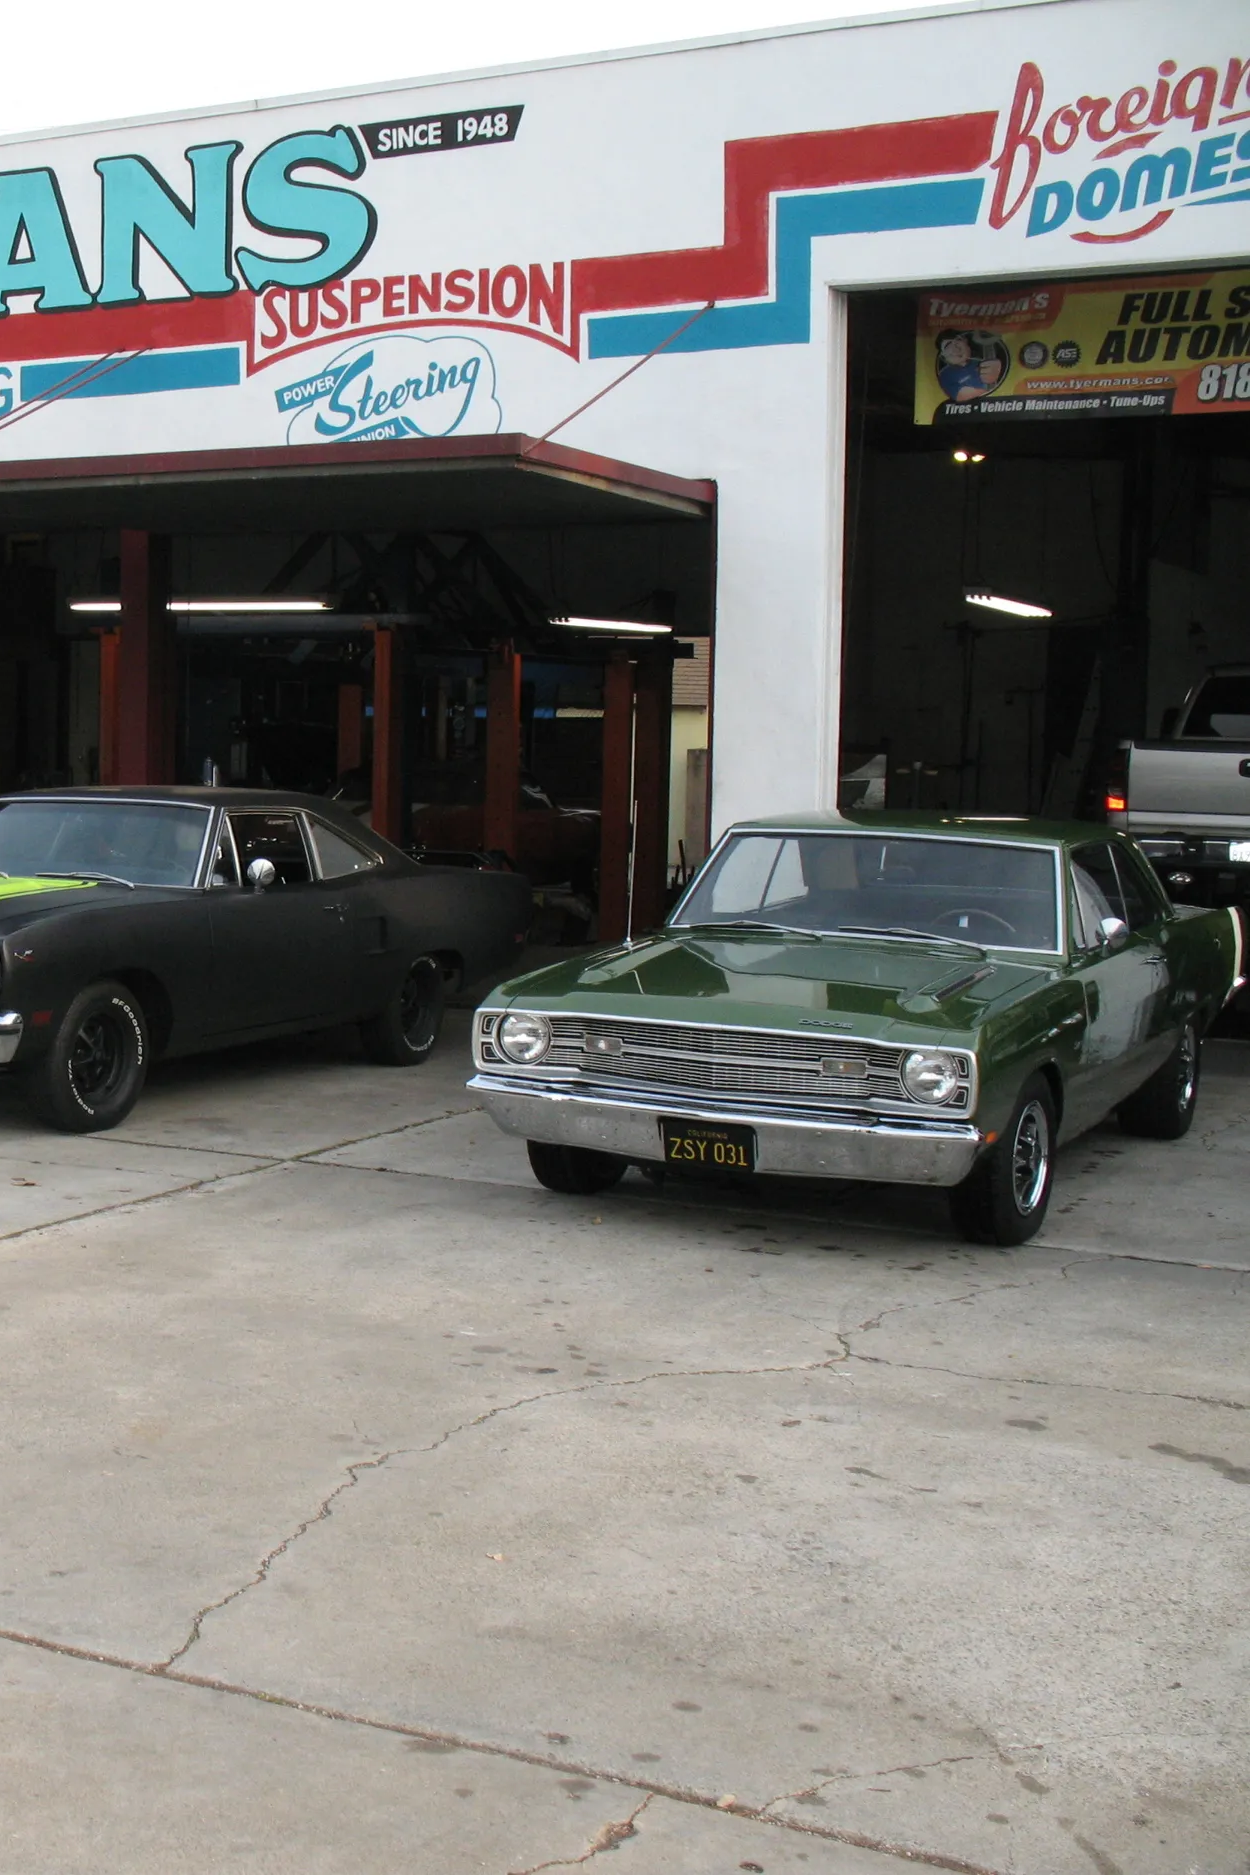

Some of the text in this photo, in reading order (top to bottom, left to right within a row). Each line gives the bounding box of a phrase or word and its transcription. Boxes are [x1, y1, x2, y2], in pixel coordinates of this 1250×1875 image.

[377, 112, 509, 152] SINCE 1948
[260, 261, 565, 350] SUSPENSION
[1116, 289, 1213, 326] FULL
[282, 375, 336, 406] POWER
[314, 349, 481, 438] Steering
[945, 394, 1166, 415] Tires Vehicle Maintenance Tune-Ups
[111, 997, 143, 1066] BFGoodrich
[798, 1018, 854, 1030] DODGE
[669, 1137, 748, 1167] ZSY 031
